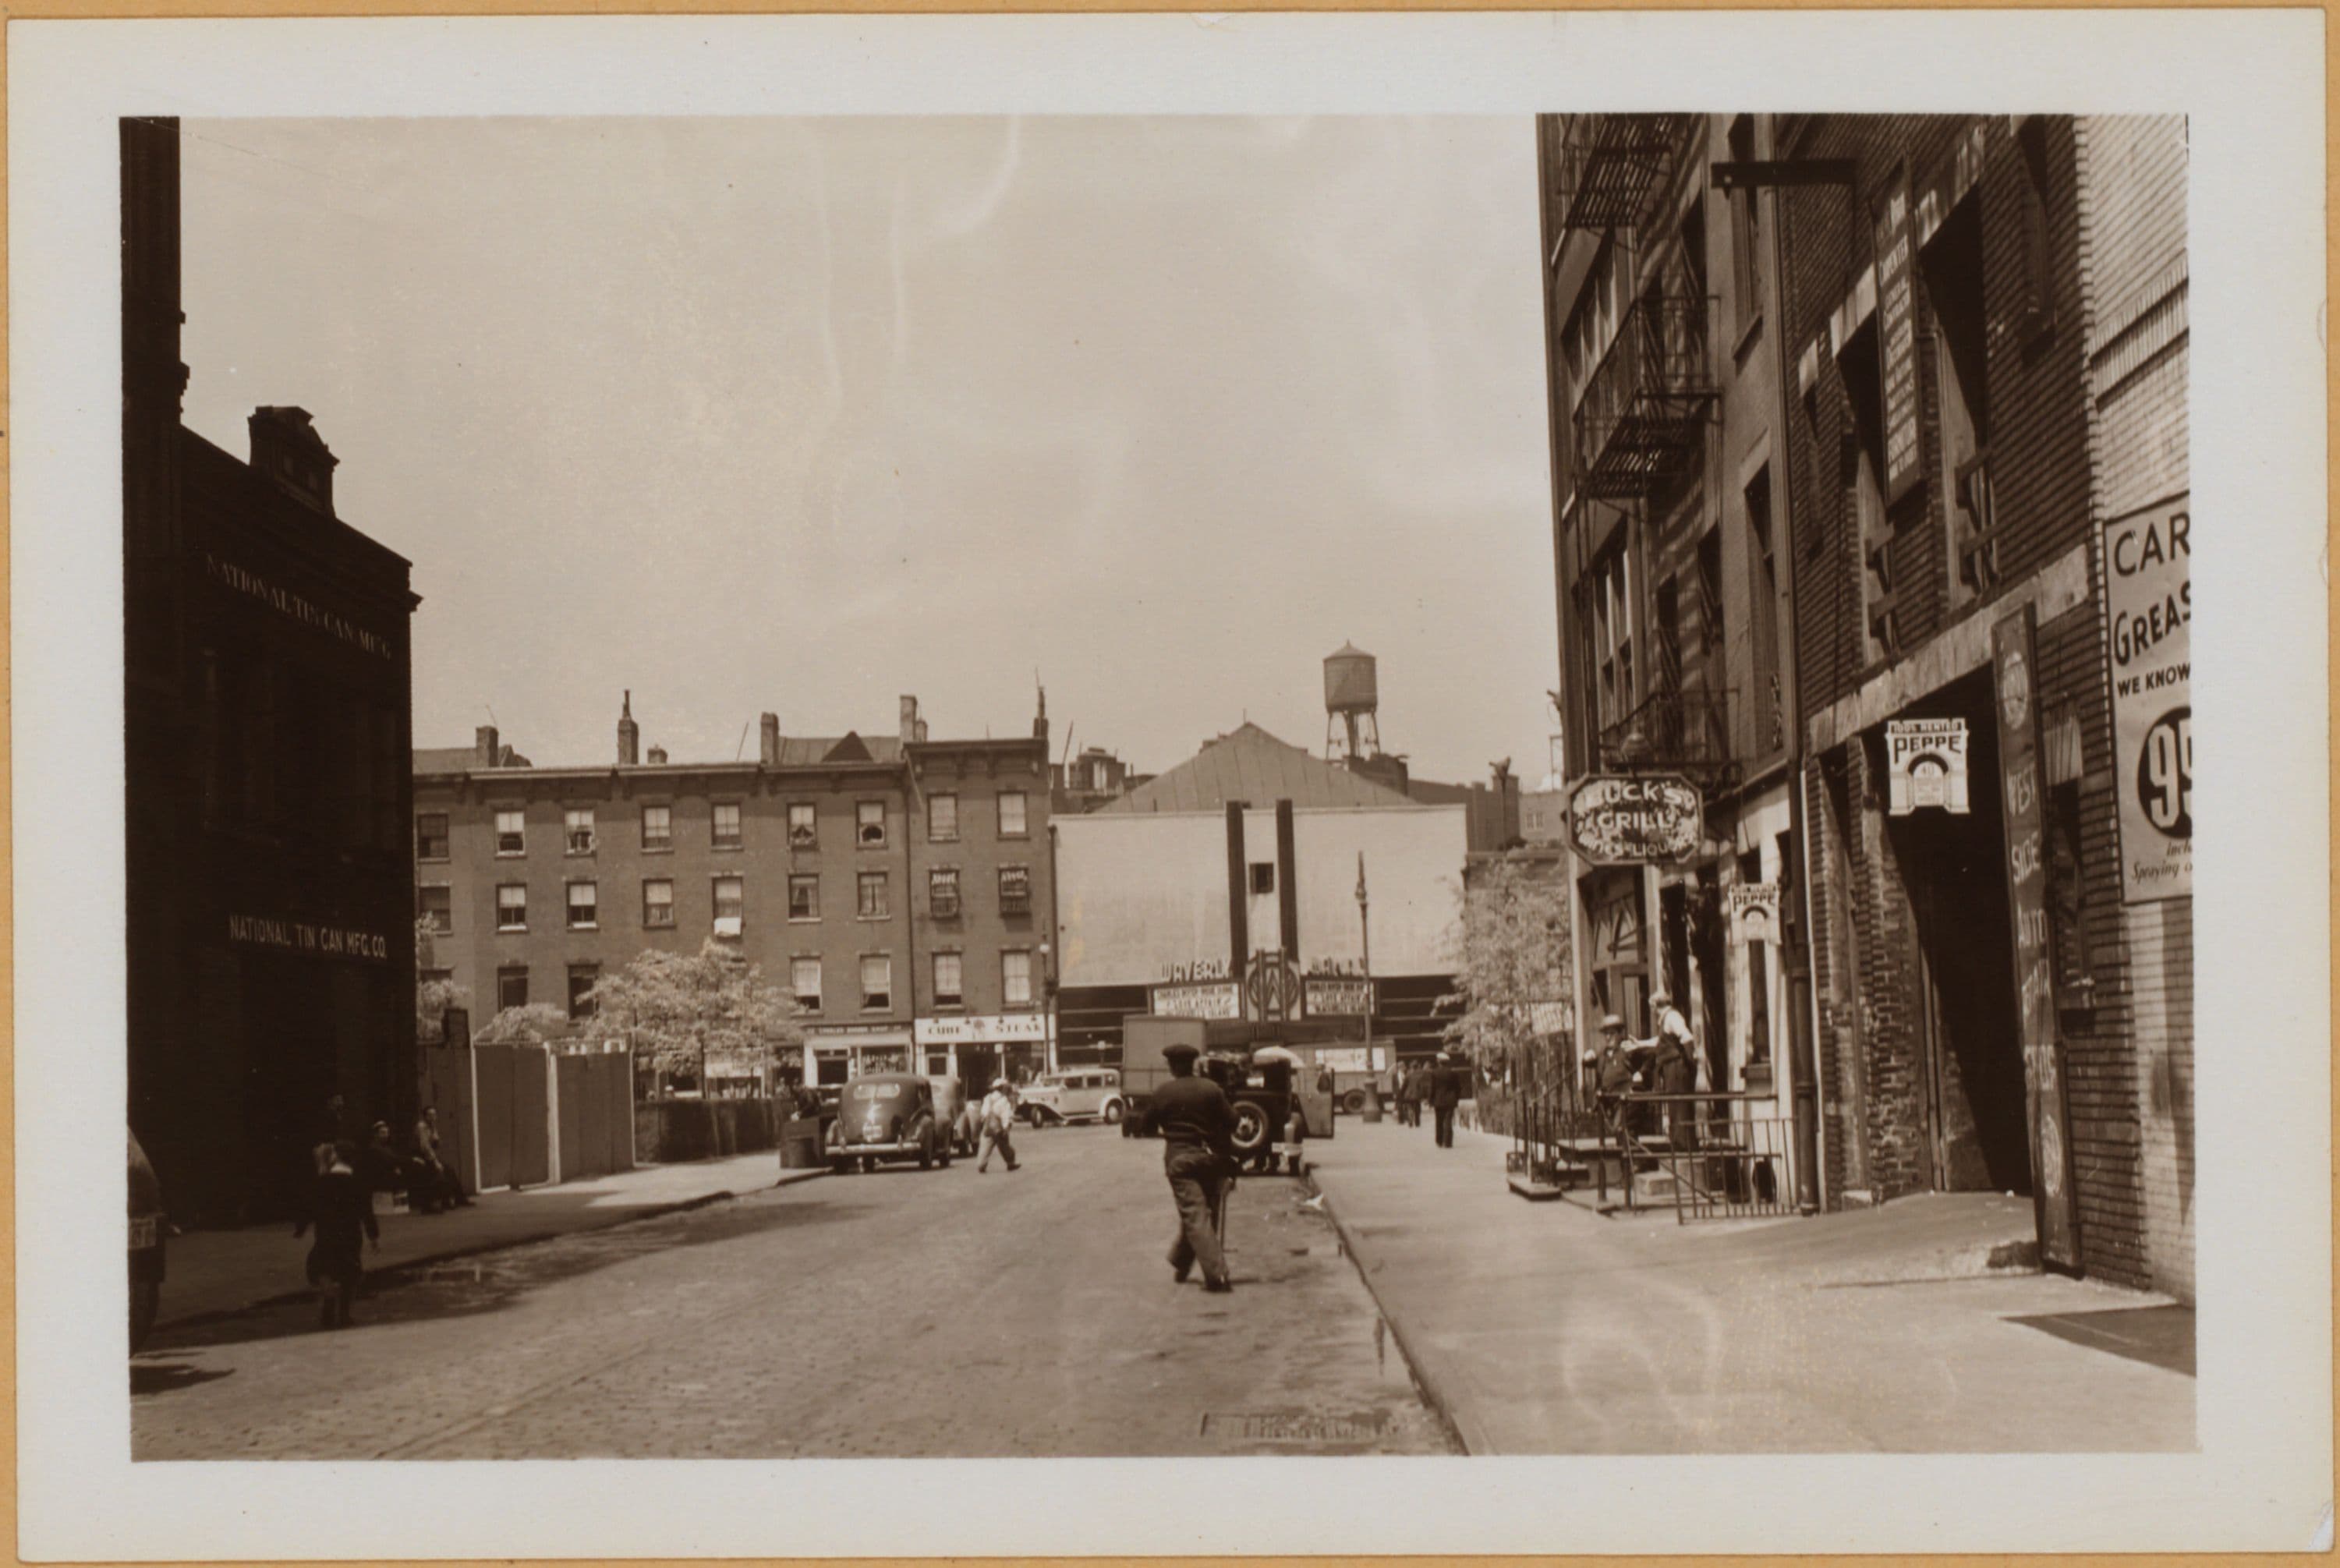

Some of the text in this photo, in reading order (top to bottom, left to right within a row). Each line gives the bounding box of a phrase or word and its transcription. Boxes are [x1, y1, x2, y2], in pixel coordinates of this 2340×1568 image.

[2114, 511, 2190, 578] CAR
[2117, 663, 2191, 698] WE KNOW
[1893, 735, 1962, 765] PEPPE
[2006, 762, 2037, 817] WEST
[1598, 810, 1674, 830] GRILL
[2011, 830, 2041, 887] SIDE
[2132, 860, 2180, 885] Spraying
[1733, 894, 1775, 913] PEPPE
[229, 915, 292, 947] NATIONAL
[295, 923, 316, 949] TIN
[320, 926, 344, 953] CAN
[1160, 960, 1231, 982] WAVERLY
